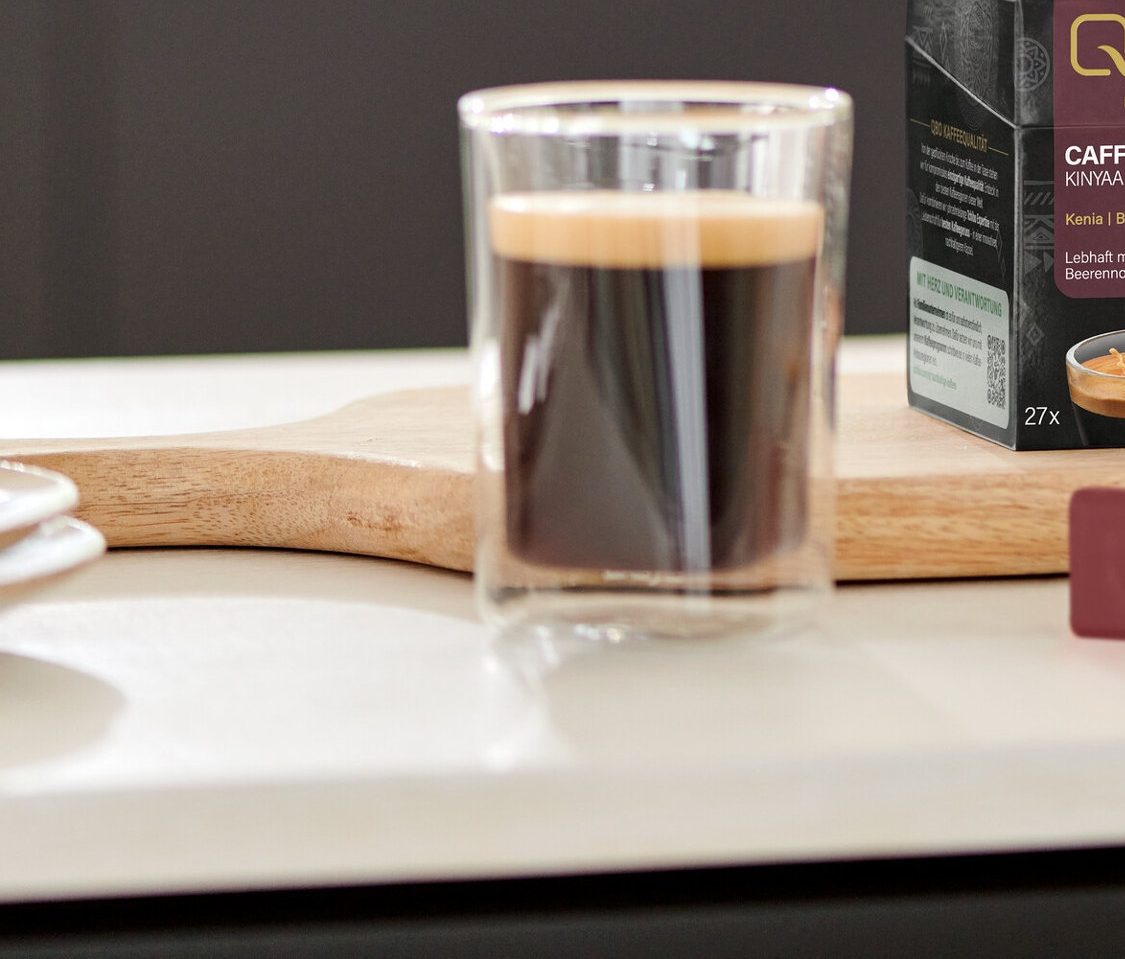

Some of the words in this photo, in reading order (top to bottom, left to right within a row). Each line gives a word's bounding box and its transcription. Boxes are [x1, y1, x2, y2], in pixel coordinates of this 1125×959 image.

[1066, 171, 1123, 186] KINYAA
[1066, 213, 1102, 225] Kenia
[1066, 251, 1113, 263] Lebhaft
[927, 274, 941, 294] HERZ
[942, 281, 953, 298] UND
[954, 285, 1002, 317] VERANTWORTUNG
[1025, 407, 1059, 425] 27x
